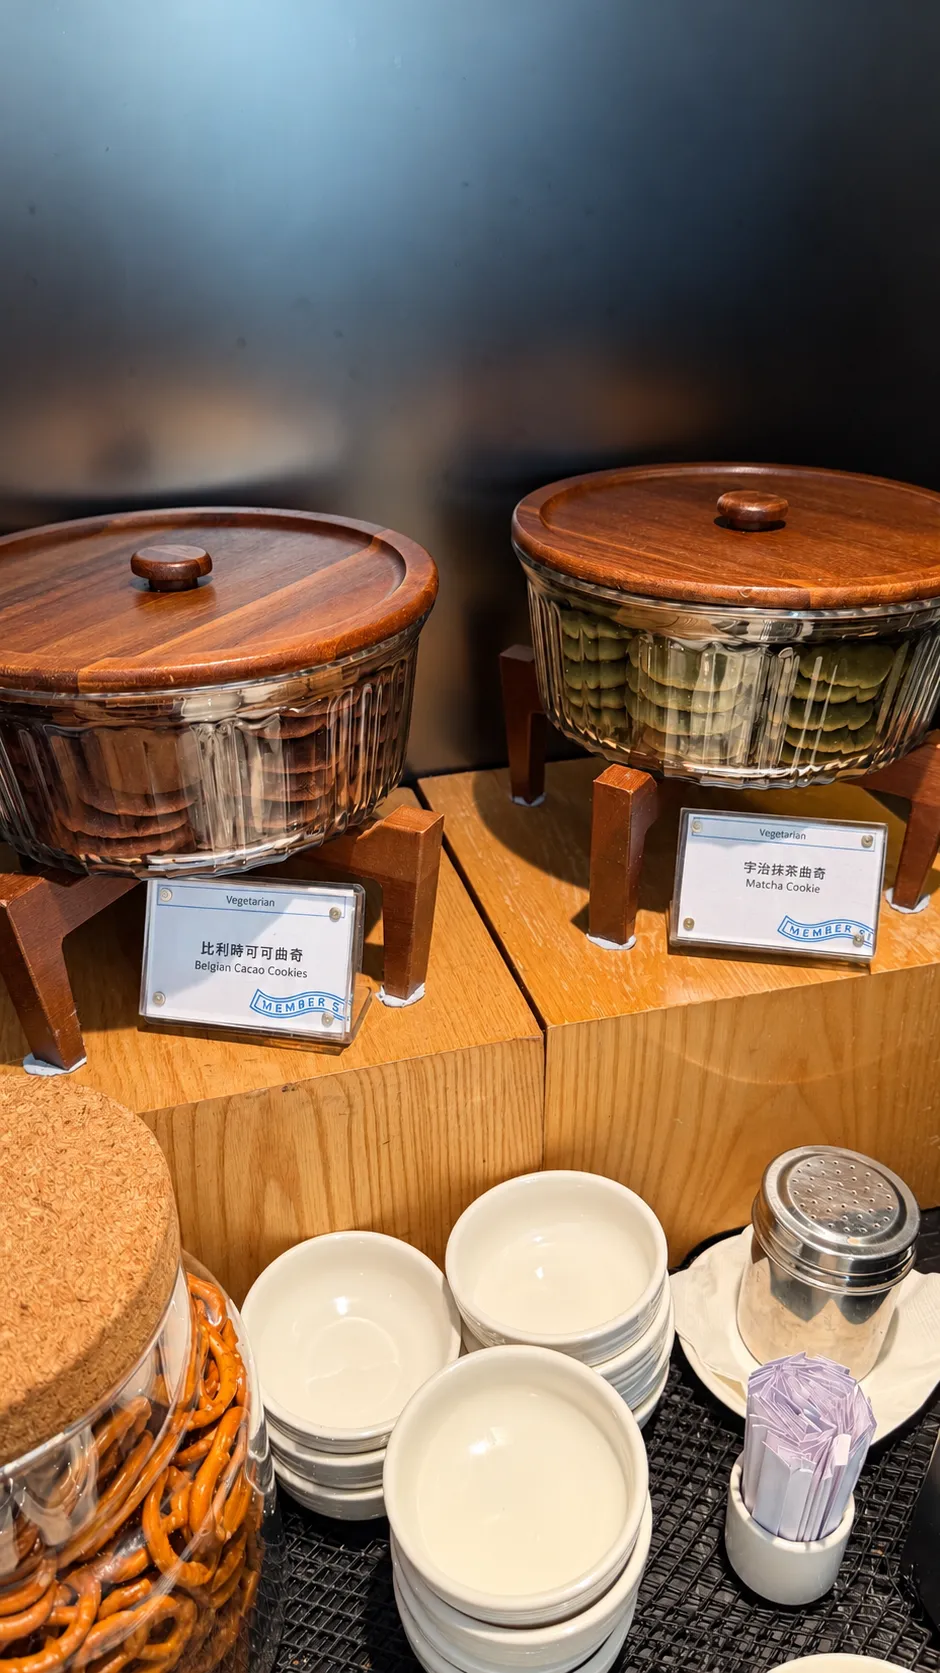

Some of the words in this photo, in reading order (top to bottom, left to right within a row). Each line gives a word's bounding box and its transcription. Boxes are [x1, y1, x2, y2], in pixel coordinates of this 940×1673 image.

[759, 828, 806, 840] Vegetarian
[743, 861, 826, 880] 宇治抹茶曲奇
[745, 879, 783, 891] Matcha
[786, 881, 820, 894] Cookie
[226, 895, 275, 908] Vegetarian
[789, 924, 852, 938] MEMBER
[200, 941, 304, 963] 比利時可可曲奇
[194, 960, 231, 973] Belgian
[234, 963, 265, 975] Cacao
[267, 966, 308, 979] Cookies
[262, 997, 325, 1013] MEMBER
